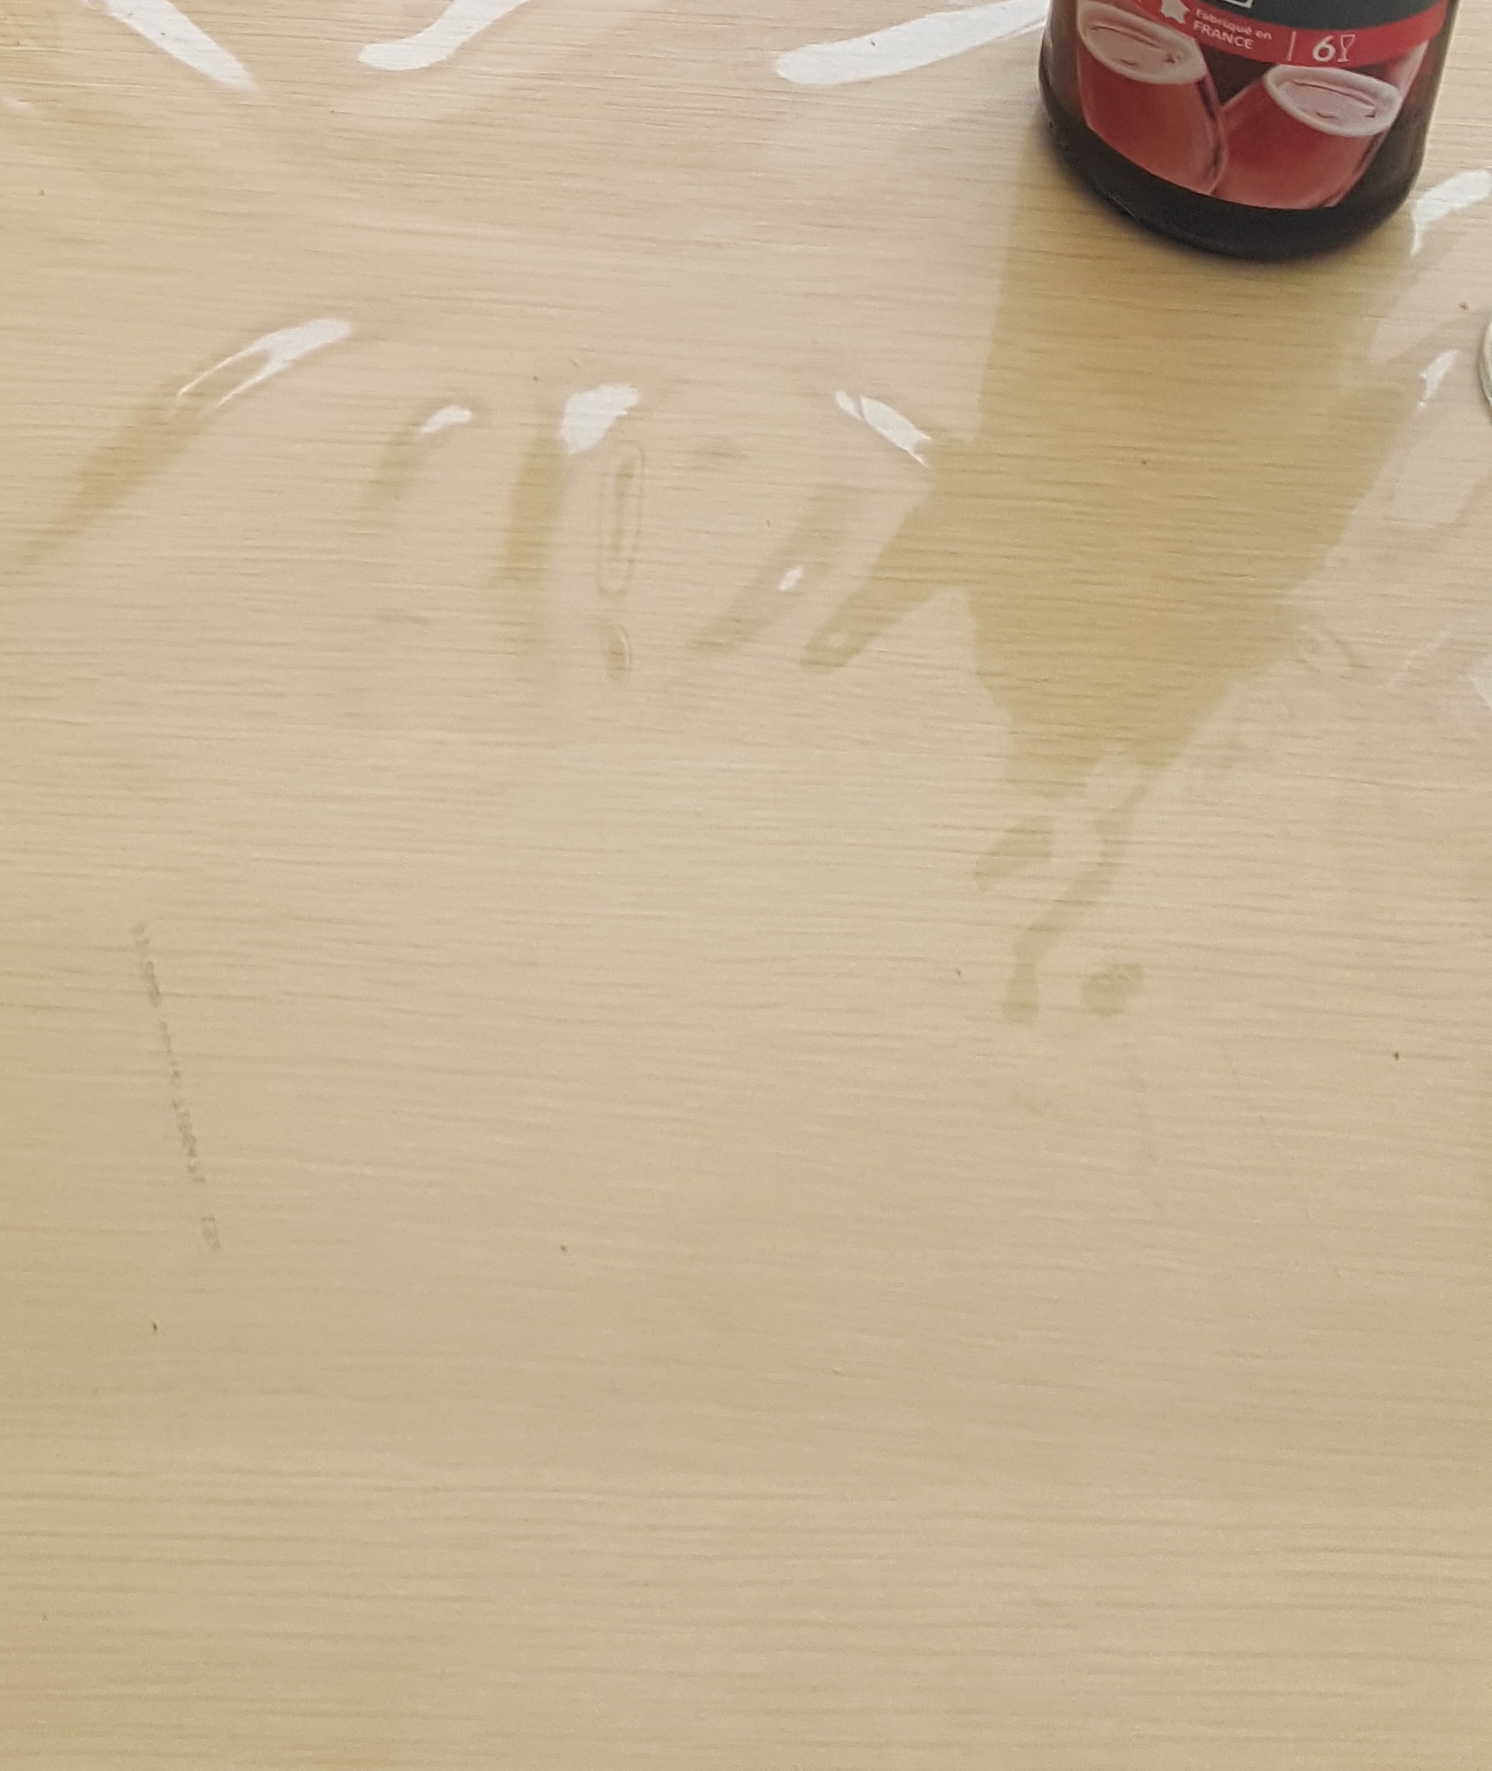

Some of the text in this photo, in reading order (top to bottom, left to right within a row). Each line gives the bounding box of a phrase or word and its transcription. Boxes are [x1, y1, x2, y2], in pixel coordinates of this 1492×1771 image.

[1192, 19, 1255, 50] FRANCE
[1195, 8, 1273, 41] Fabriqué en
[1312, 35, 1337, 63] 6
